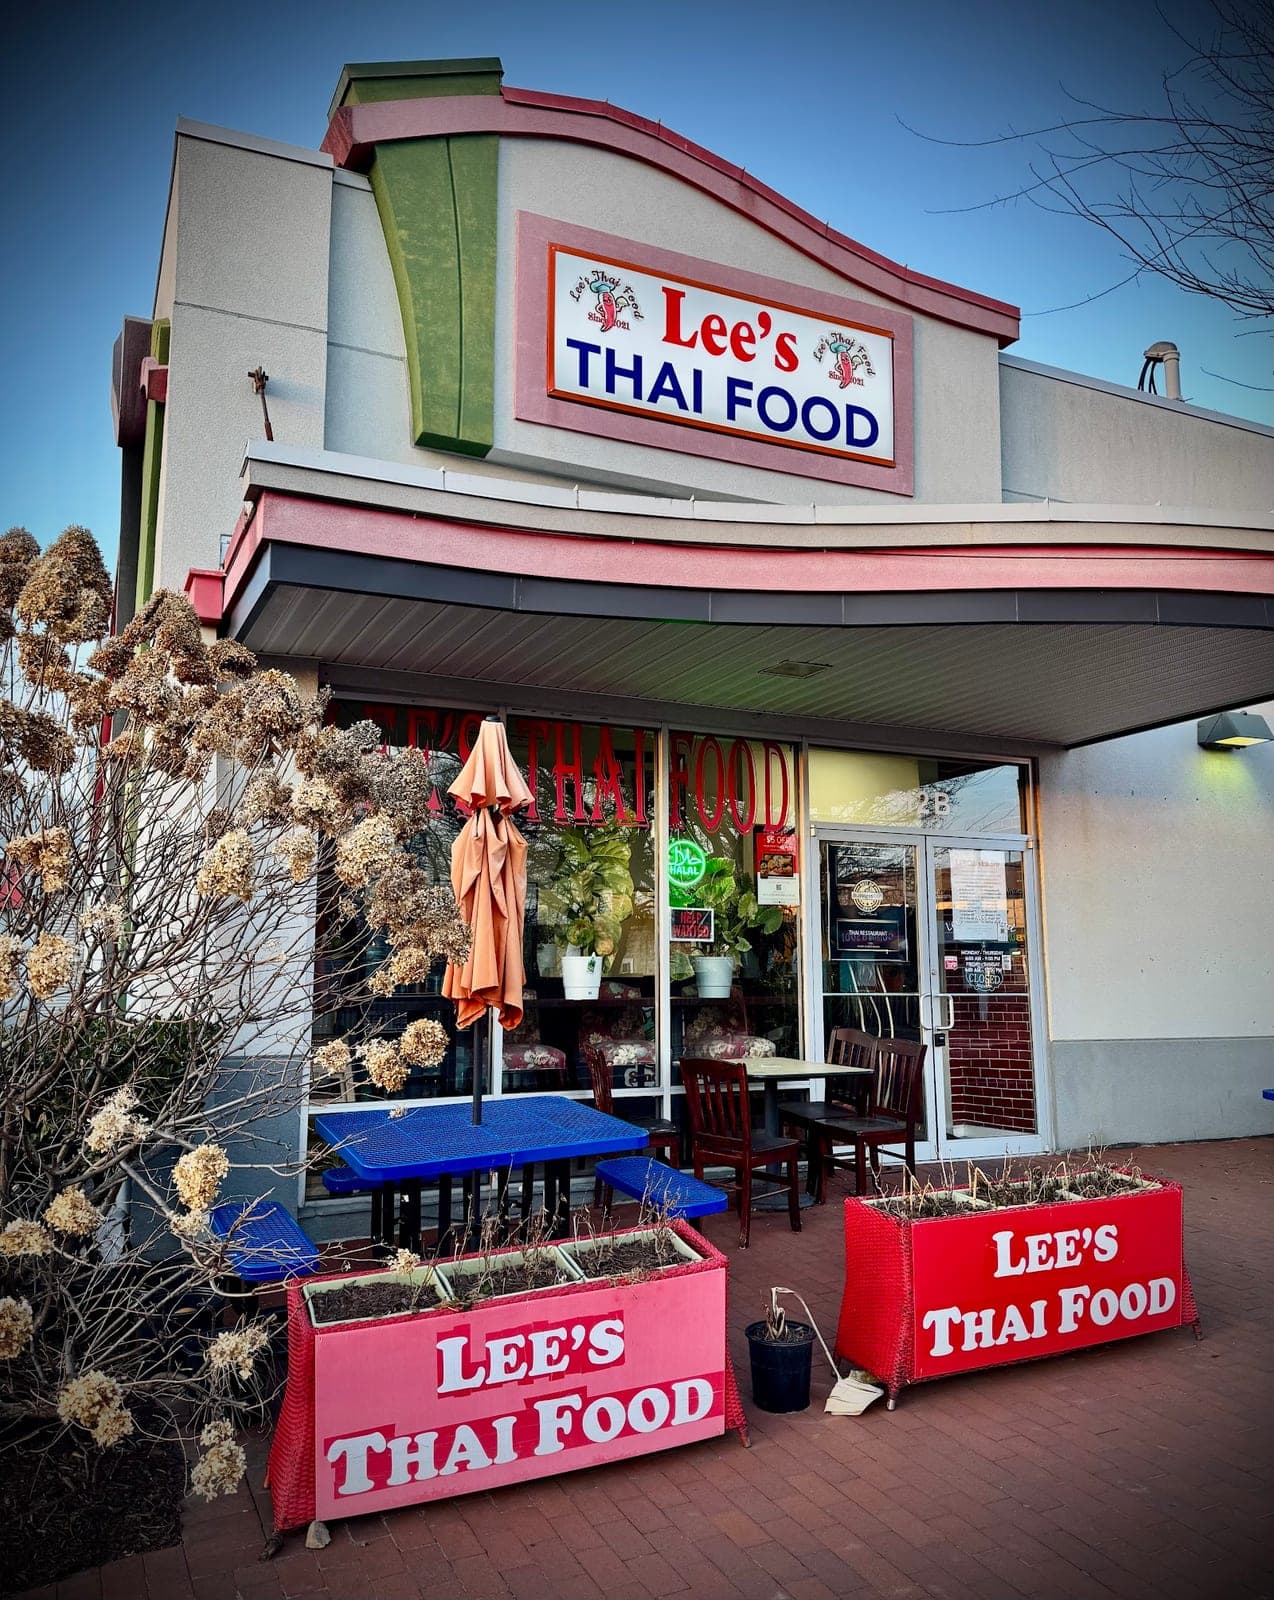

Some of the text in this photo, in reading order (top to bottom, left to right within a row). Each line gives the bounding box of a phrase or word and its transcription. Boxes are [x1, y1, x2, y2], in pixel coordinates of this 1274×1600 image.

[569, 270, 644, 320] Lee's Thai Food
[661, 286, 799, 373] Lee's
[831, 332, 855, 346] Thai
[857, 345, 876, 375] Food
[566, 337, 880, 449] THAI FOOD
[515, 718, 650, 829] THAI
[668, 732, 790, 835] FOOD
[669, 865, 699, 876] HALAL
[673, 924, 710, 938] WANTED
[680, 911, 702, 923] HELP
[968, 974, 1001, 985] CLOSED
[992, 1224, 1119, 1279] LEE'S
[922, 1277, 1176, 1358] THAI FOOD
[436, 1319, 626, 1394] LEE'S
[327, 1377, 715, 1496] THAI FOOD
